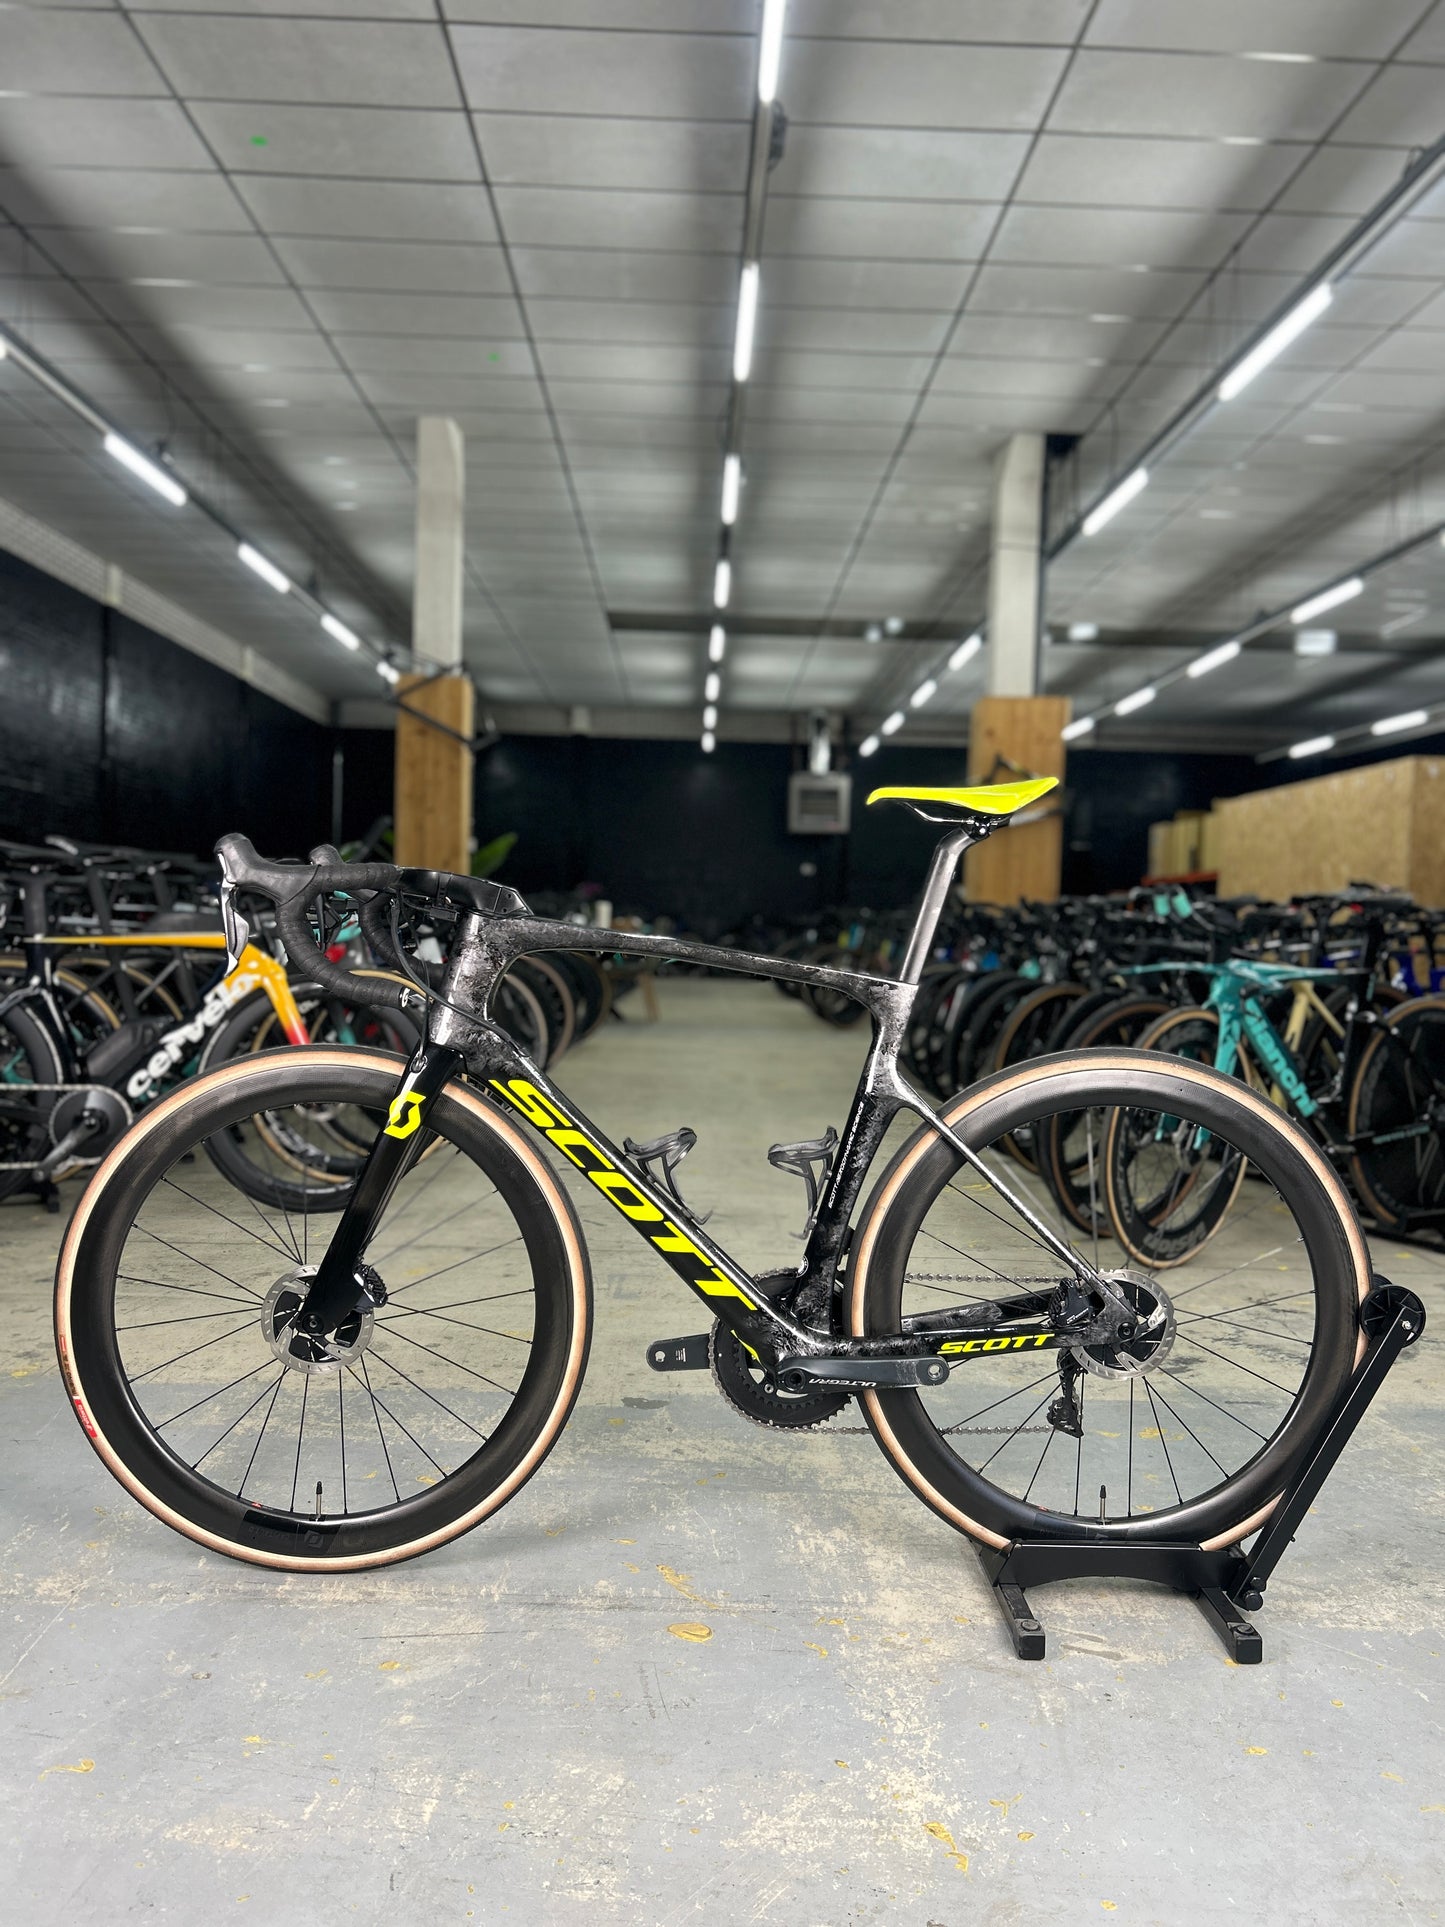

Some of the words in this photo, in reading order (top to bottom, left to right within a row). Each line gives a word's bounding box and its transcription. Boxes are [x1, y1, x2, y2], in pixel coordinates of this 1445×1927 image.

[828, 1183, 838, 1209] SCOTT
[851, 1101, 864, 1133] SCIENCE
[489, 1079, 758, 1310] SCOTT
[937, 1333, 1055, 1355] SCOTT
[809, 1378, 877, 1387] ULTEGRA
